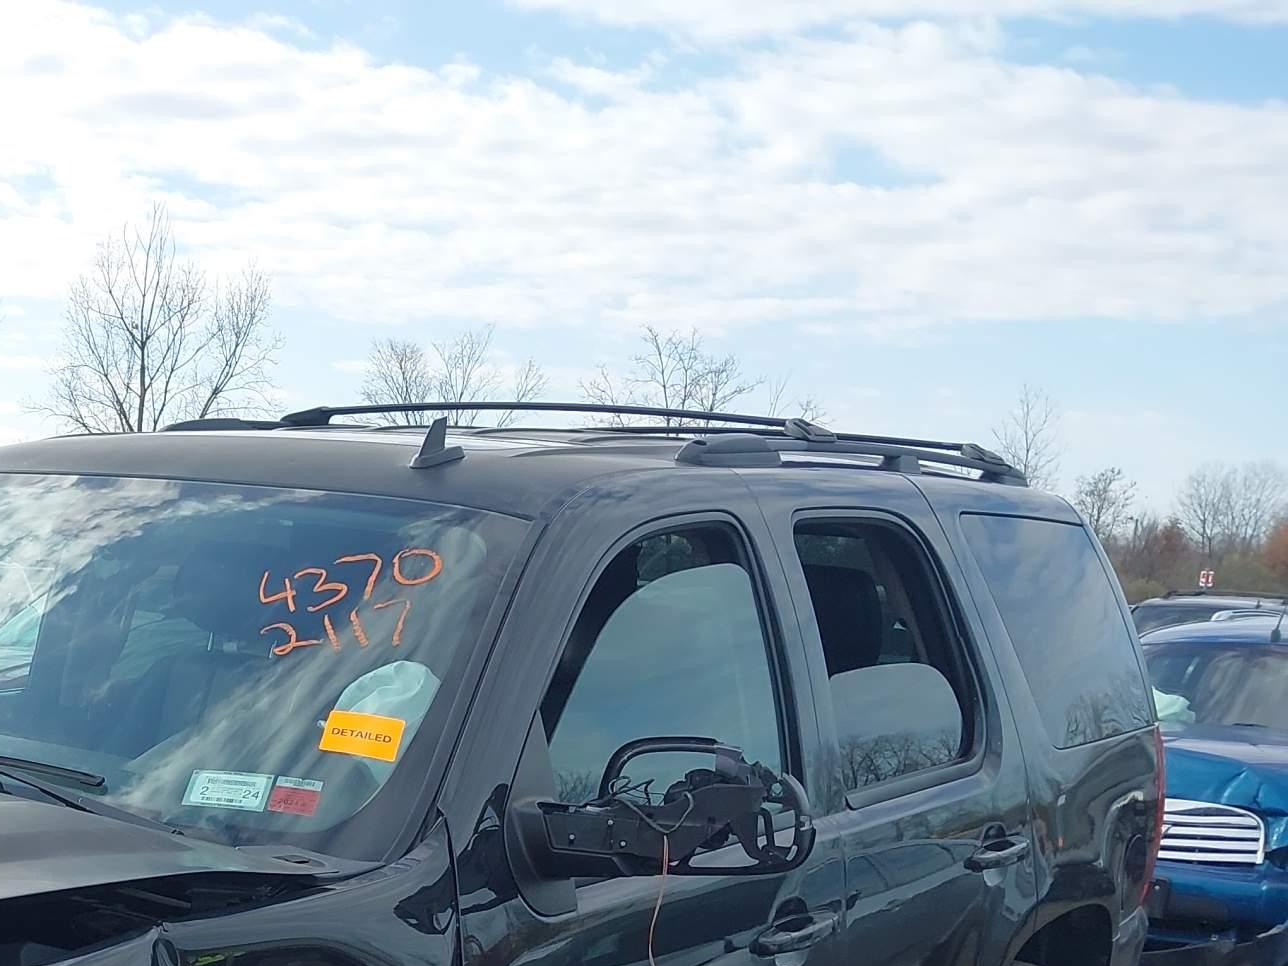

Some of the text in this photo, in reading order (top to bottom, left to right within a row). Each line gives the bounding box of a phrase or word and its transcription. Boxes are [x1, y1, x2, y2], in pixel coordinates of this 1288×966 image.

[259, 549, 443, 612] 4370
[260, 600, 411, 656] 2117
[330, 727, 393, 744] DETAILED
[242, 789, 260, 800] 24
